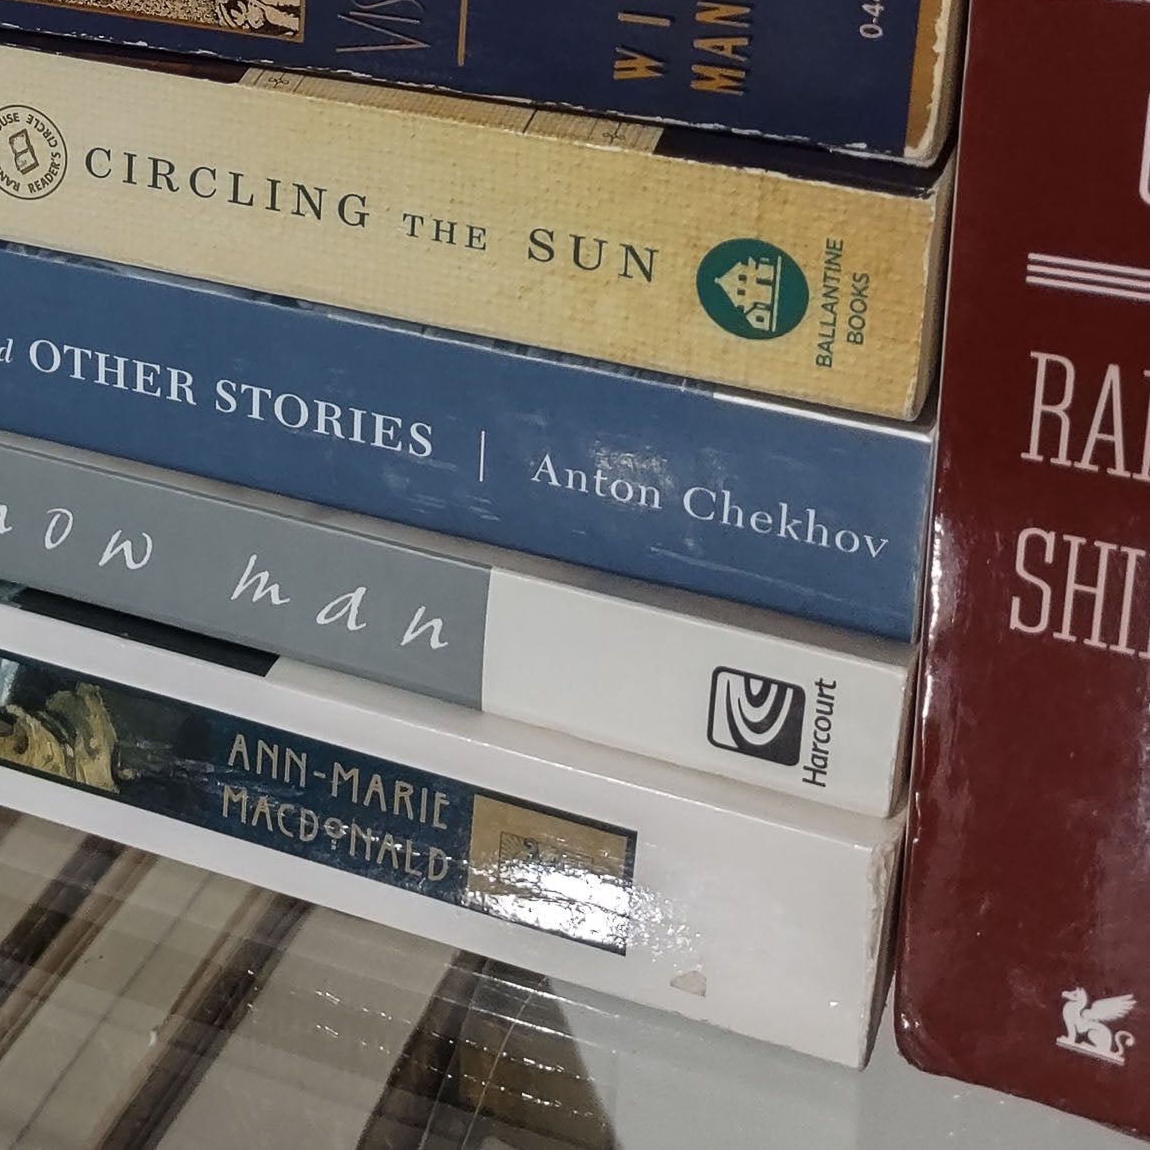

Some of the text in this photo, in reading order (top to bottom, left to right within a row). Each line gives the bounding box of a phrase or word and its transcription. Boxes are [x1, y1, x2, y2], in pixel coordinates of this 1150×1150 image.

[26, 113, 61, 194] READER'S CIRCLE
[85, 147, 660, 284] CIRCLING THE SUN
[816, 238, 844, 368] BALLANTINE
[846, 272, 870, 345] BOOKS
[28, 338, 198, 406] OTHER
[214, 379, 434, 458] STORIES
[530, 452, 889, 560] Anton Chekhov
[228, 733, 450, 831] ANN-MARIE
[802, 677, 837, 787] Harcourt
[222, 785, 450, 882] MACDONALD
